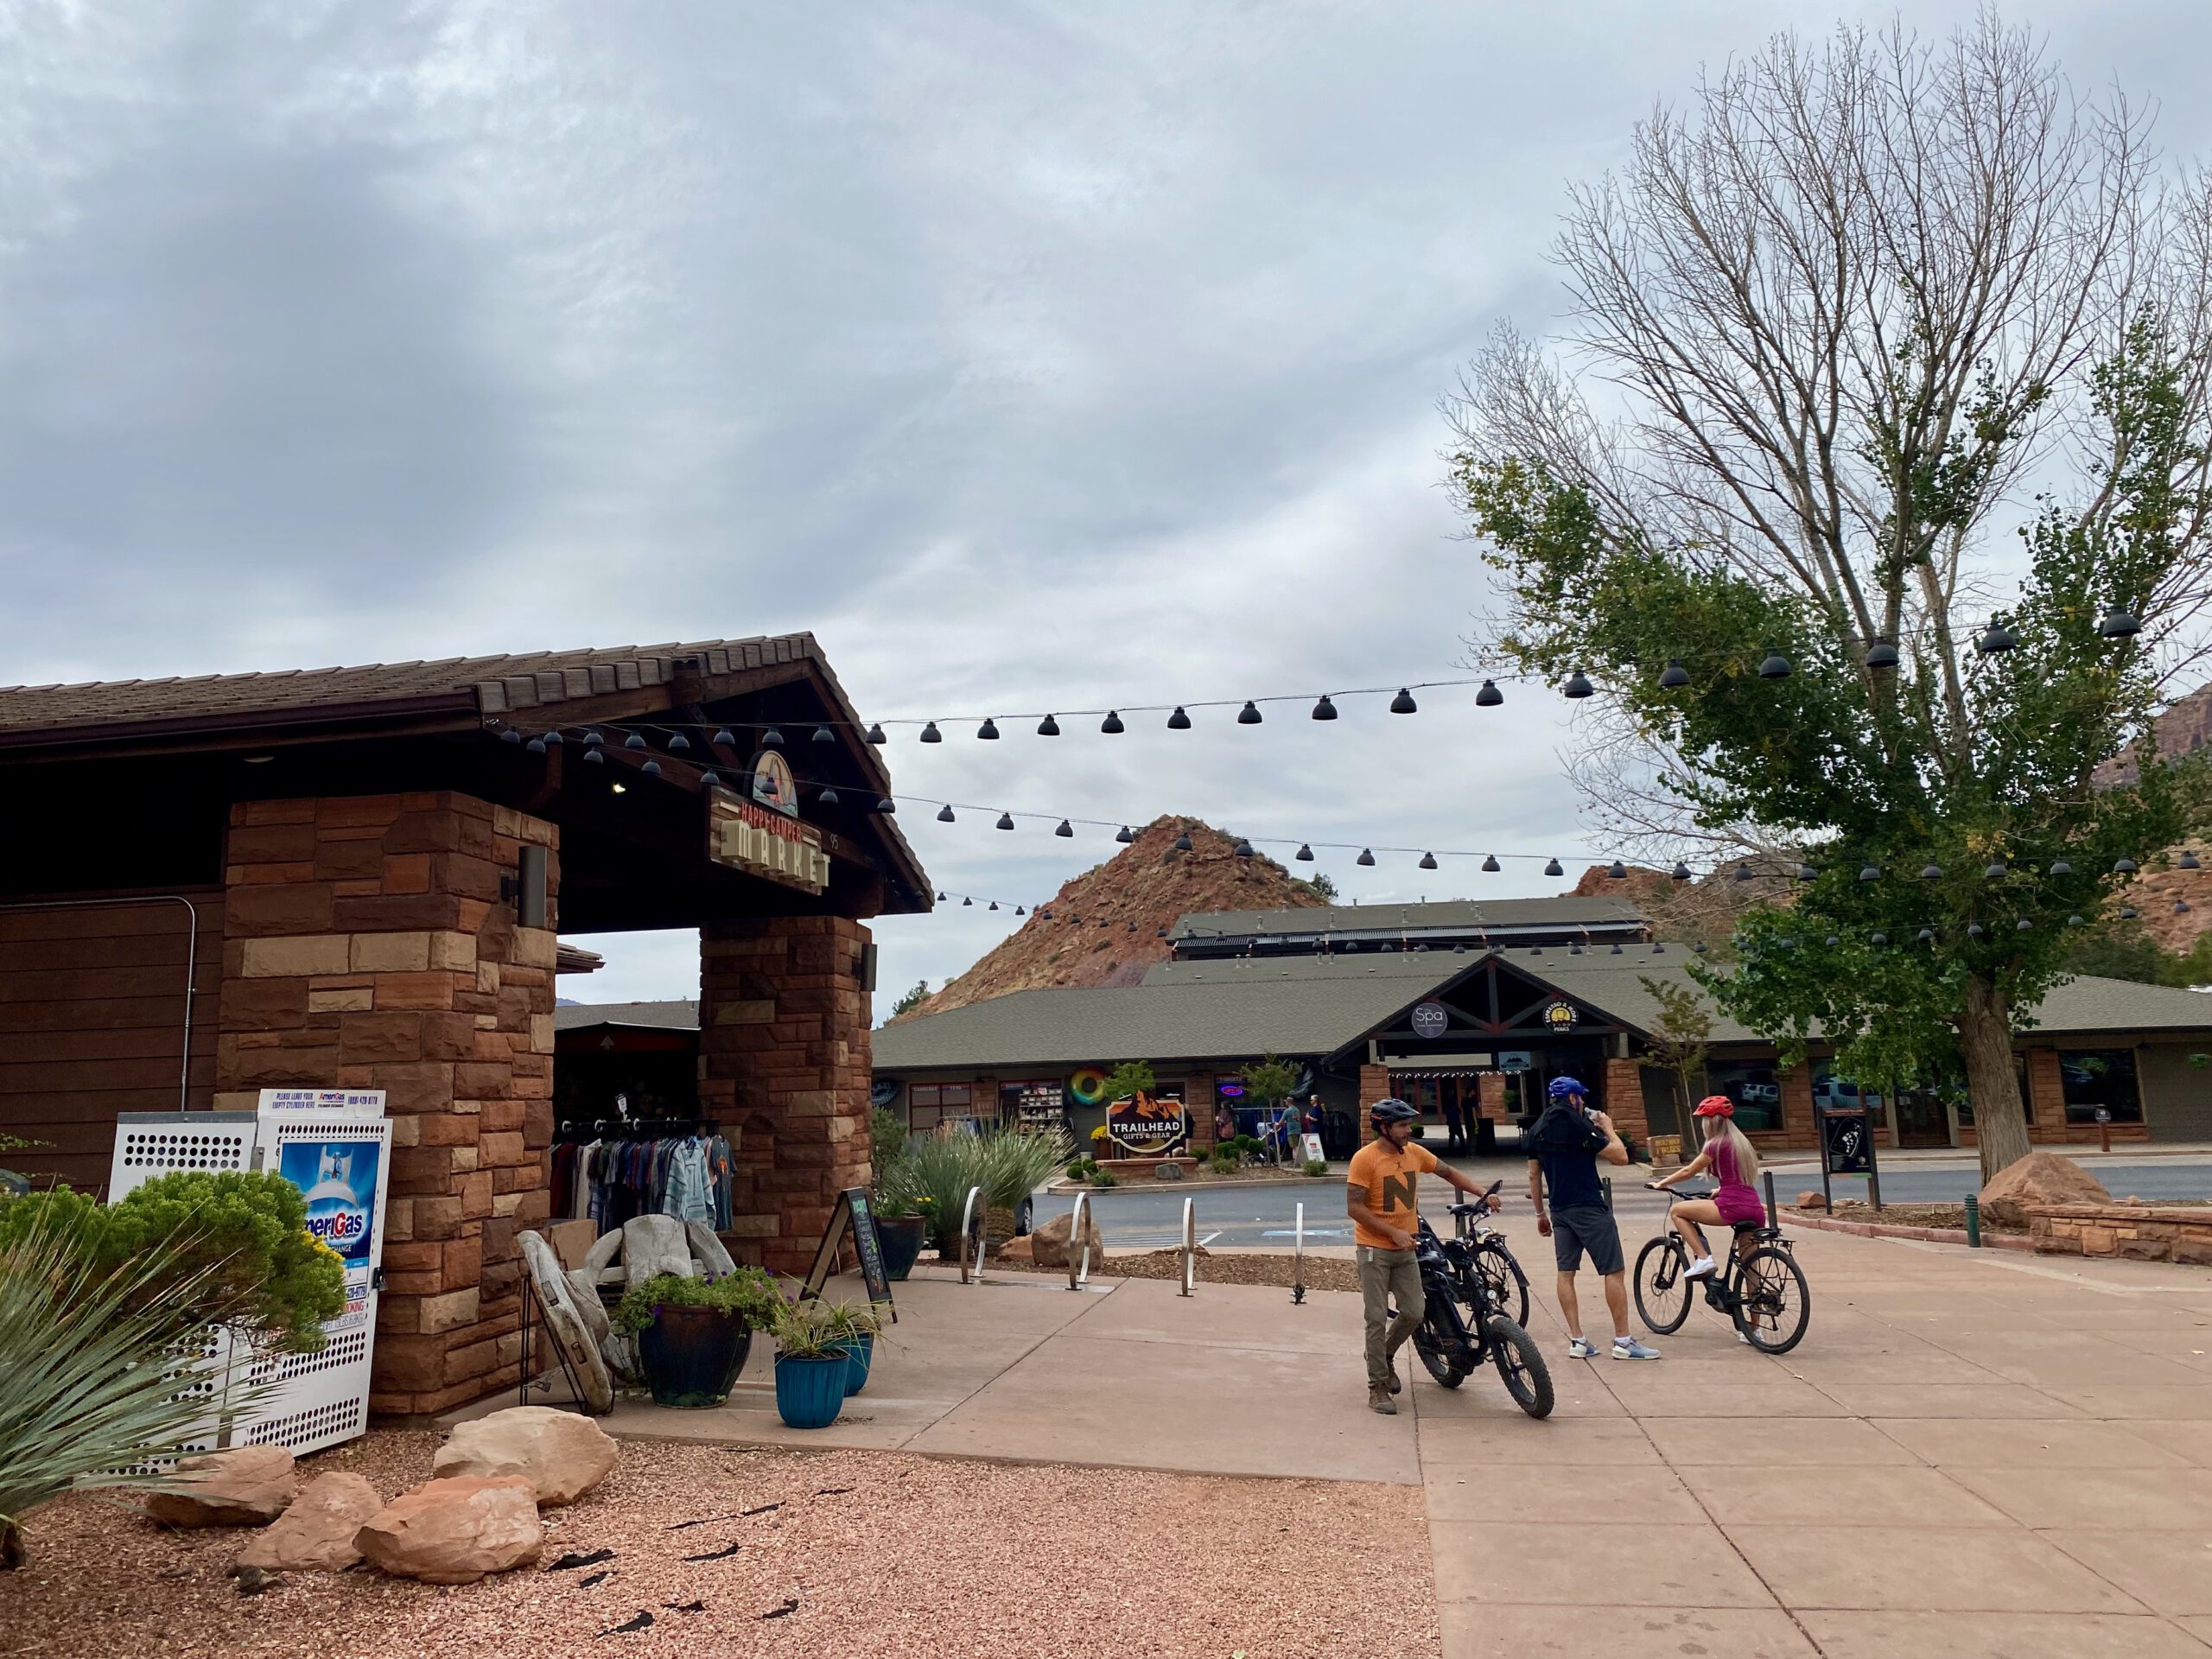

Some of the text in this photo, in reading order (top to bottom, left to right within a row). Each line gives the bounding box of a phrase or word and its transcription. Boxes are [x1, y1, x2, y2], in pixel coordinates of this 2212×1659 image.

[830, 834, 838, 849] 95
[721, 819, 830, 887] MARKET
[1416, 1007, 1443, 1026] Spa
[1545, 1001, 1561, 1023] ESPRESSO
[1113, 1122, 1179, 1133] TRAILHEAD
[1382, 1171, 1416, 1212] N
[304, 1212, 363, 1236] meriGas
